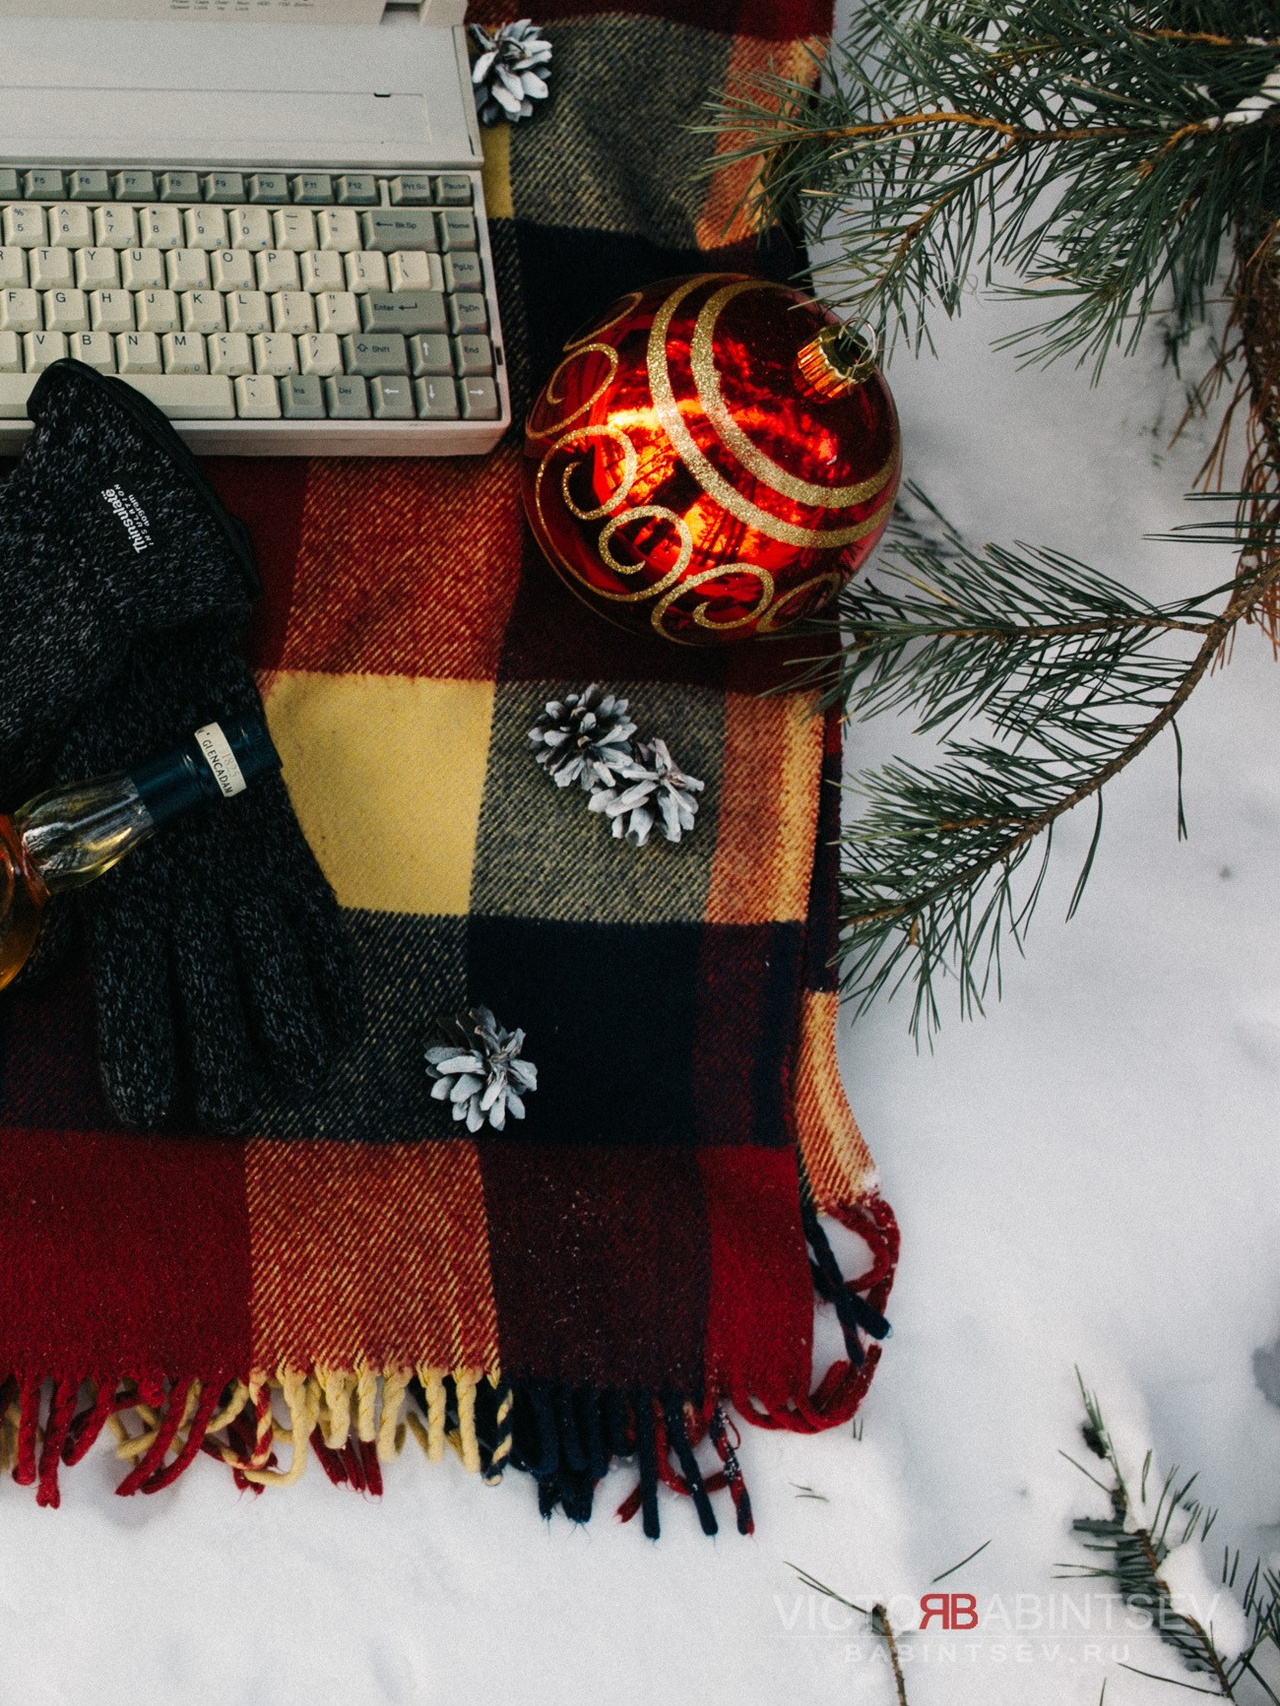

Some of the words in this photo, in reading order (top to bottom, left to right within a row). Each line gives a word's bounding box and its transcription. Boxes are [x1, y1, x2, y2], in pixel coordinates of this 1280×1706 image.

[260, 180, 275, 188] F10
[40, 250, 50, 260] T
[87, 250, 97, 260] Y
[132, 251, 142, 262] U
[222, 251, 234, 263] O
[267, 252, 277, 262] P
[8, 292, 18, 302] F
[55, 292, 67, 303] G
[102, 292, 112, 303] H
[147, 294, 156, 304] J
[192, 294, 203, 304] K
[238, 294, 248, 304] L
[373, 302, 395, 311] Enter
[36, 334, 46, 345] V
[82, 334, 92, 346] B
[128, 334, 138, 346] N
[174, 336, 187, 346] M
[372, 345, 390, 354] Shift
[338, 386, 352, 394] Del
[114, 484, 154, 546] INSULATION
